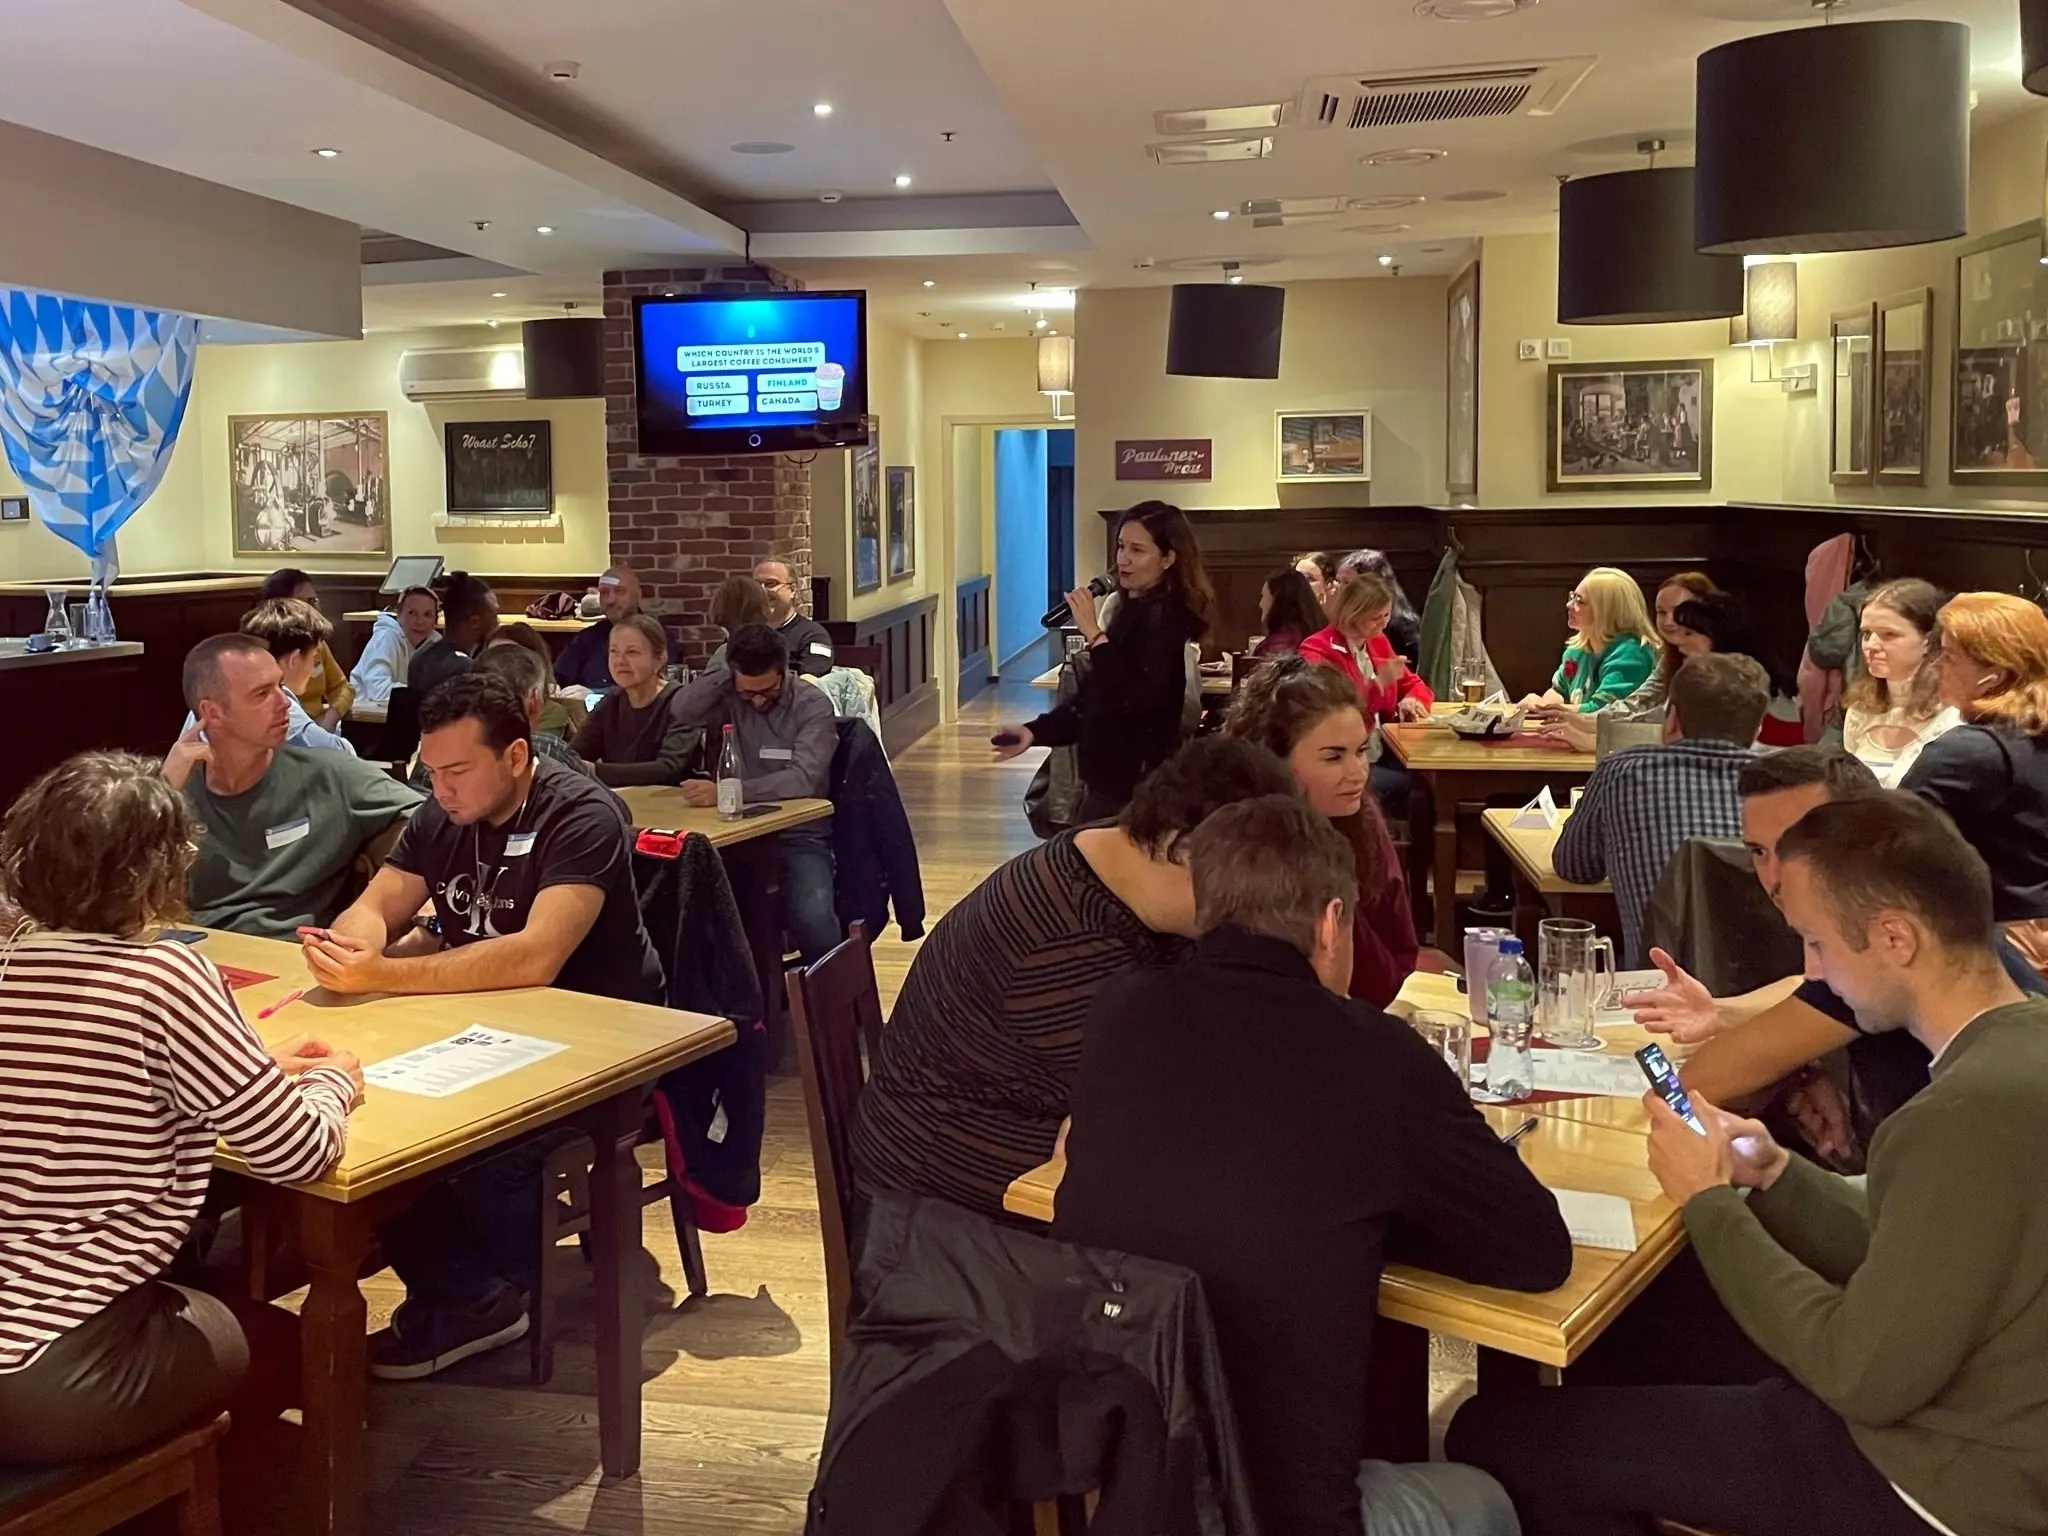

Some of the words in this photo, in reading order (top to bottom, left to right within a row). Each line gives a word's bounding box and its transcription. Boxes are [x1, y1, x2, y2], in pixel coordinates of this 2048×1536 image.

[683, 350, 713, 358] WHICH
[715, 349, 754, 357] COUNTRY
[756, 348, 765, 356] IS
[691, 359, 728, 367] LARGEST
[730, 358, 761, 366] COFFEE
[762, 356, 813, 365] CONSUMER?
[696, 381, 731, 390] RUSSIA
[767, 379, 808, 387] FINLAND
[697, 399, 732, 408] TURKEY
[762, 397, 801, 406] CANADA
